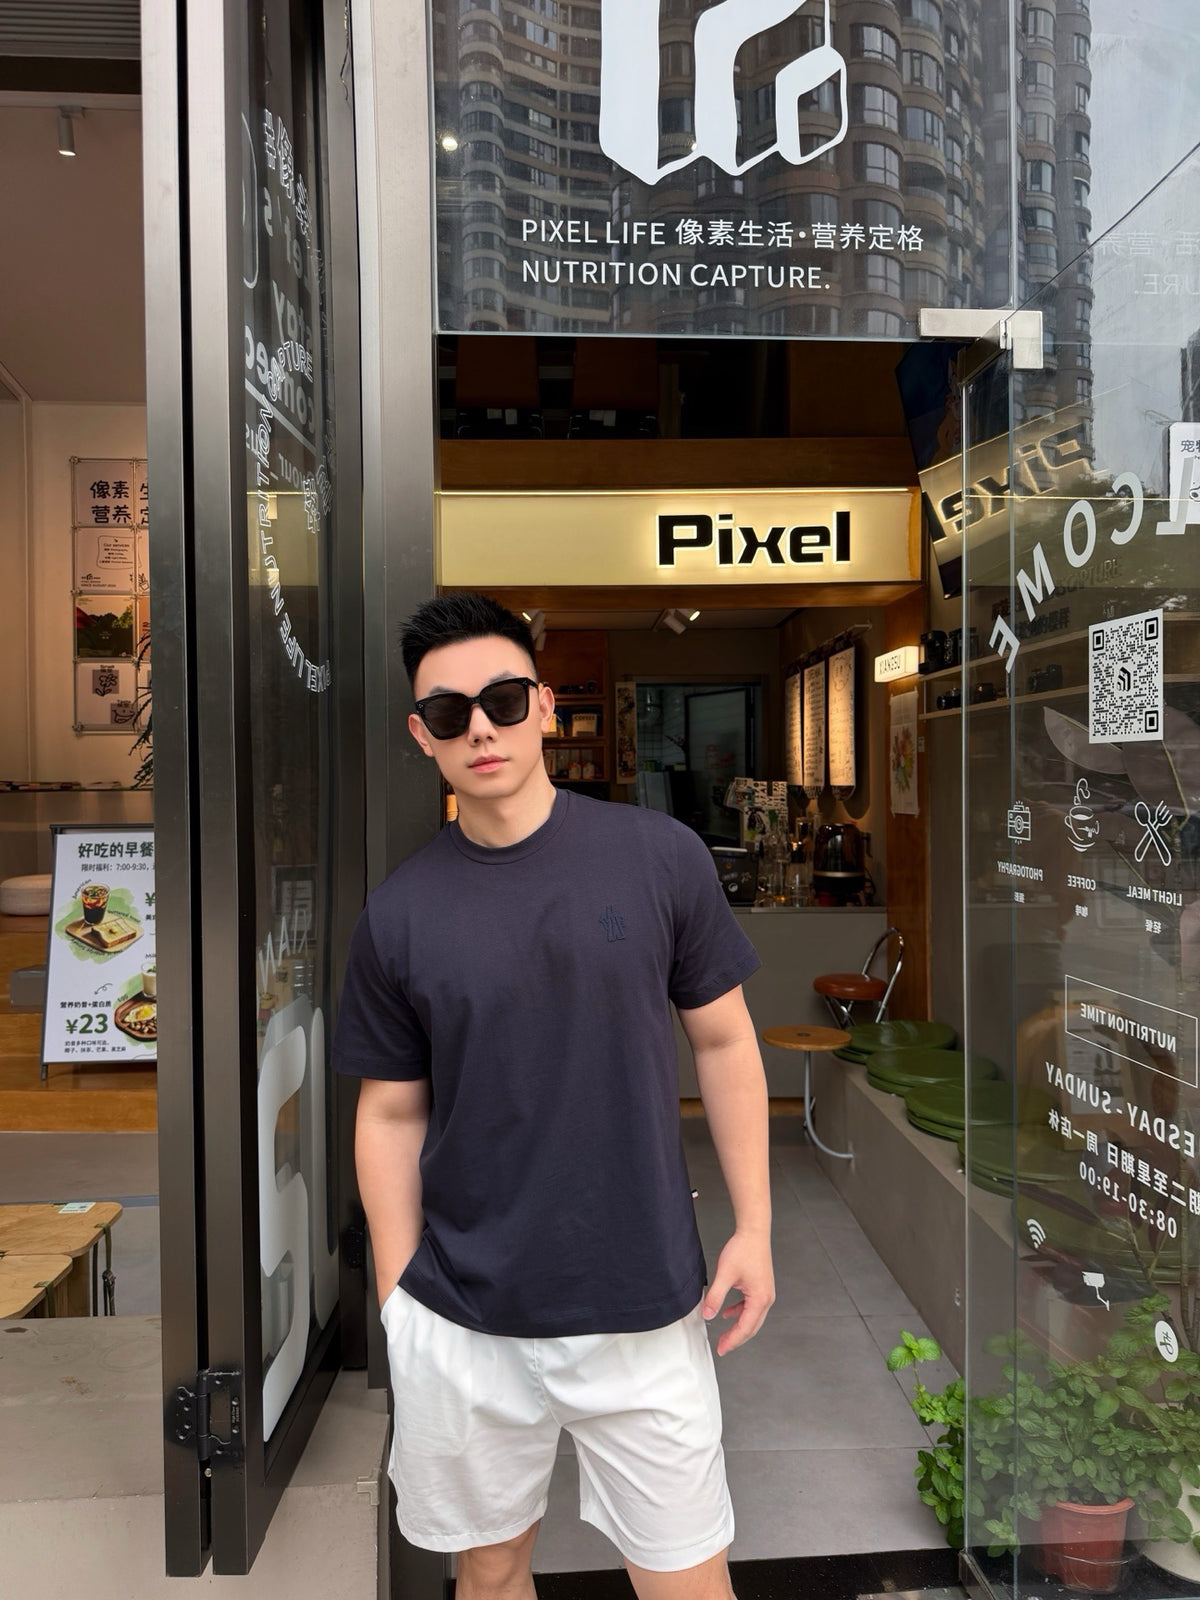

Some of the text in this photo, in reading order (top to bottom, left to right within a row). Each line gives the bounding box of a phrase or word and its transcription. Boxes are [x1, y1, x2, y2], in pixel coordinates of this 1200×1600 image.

[522, 219, 925, 253] PIXEL LIFE 像素生活·营养定格
[522, 261, 832, 290] NUTRITION CAPTURE.
[657, 510, 851, 567] Pixel
[65, 1012, 109, 1035] ¥23
